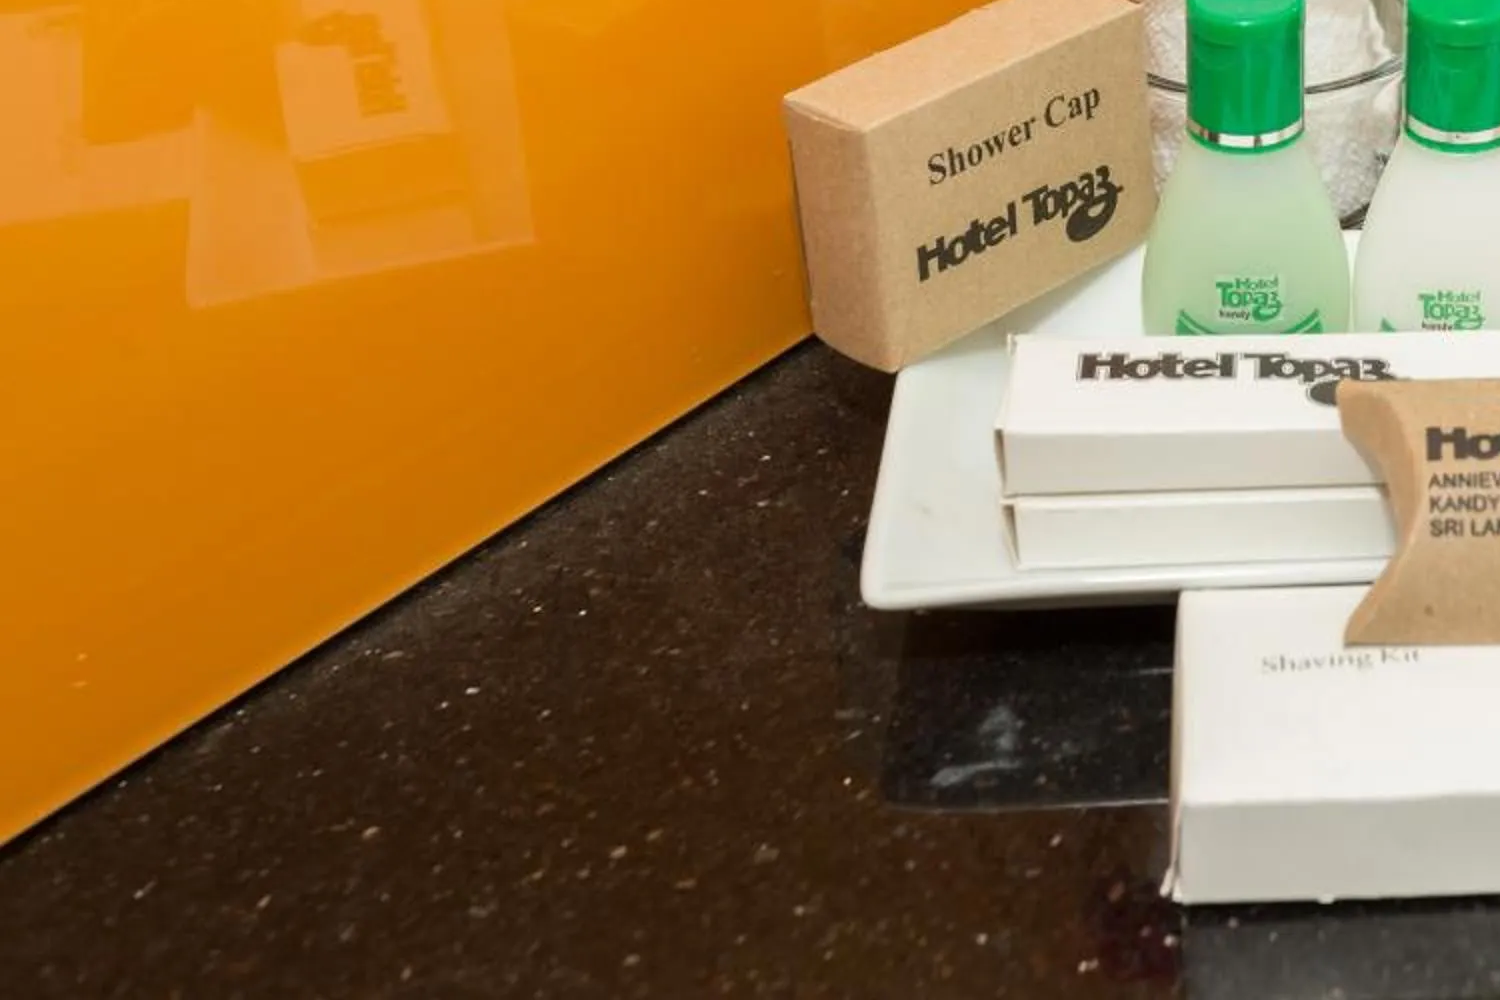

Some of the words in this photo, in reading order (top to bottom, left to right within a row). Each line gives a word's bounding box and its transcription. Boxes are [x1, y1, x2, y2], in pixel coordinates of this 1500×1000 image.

[927, 116, 1036, 187] Shower
[1044, 87, 1101, 129] Cap
[916, 203, 1018, 282] Hotel
[1022, 165, 1124, 243] Topaz
[1235, 275, 1279, 289] Hotel
[1437, 290, 1481, 302] Hotel
[1216, 281, 1283, 322] Topaz
[1418, 293, 1486, 330] Topaz
[1078, 352, 1239, 381] Hotel
[1429, 518, 1465, 538] SRI
[1261, 653, 1375, 675] Shaving
[1380, 648, 1420, 664] Kit
